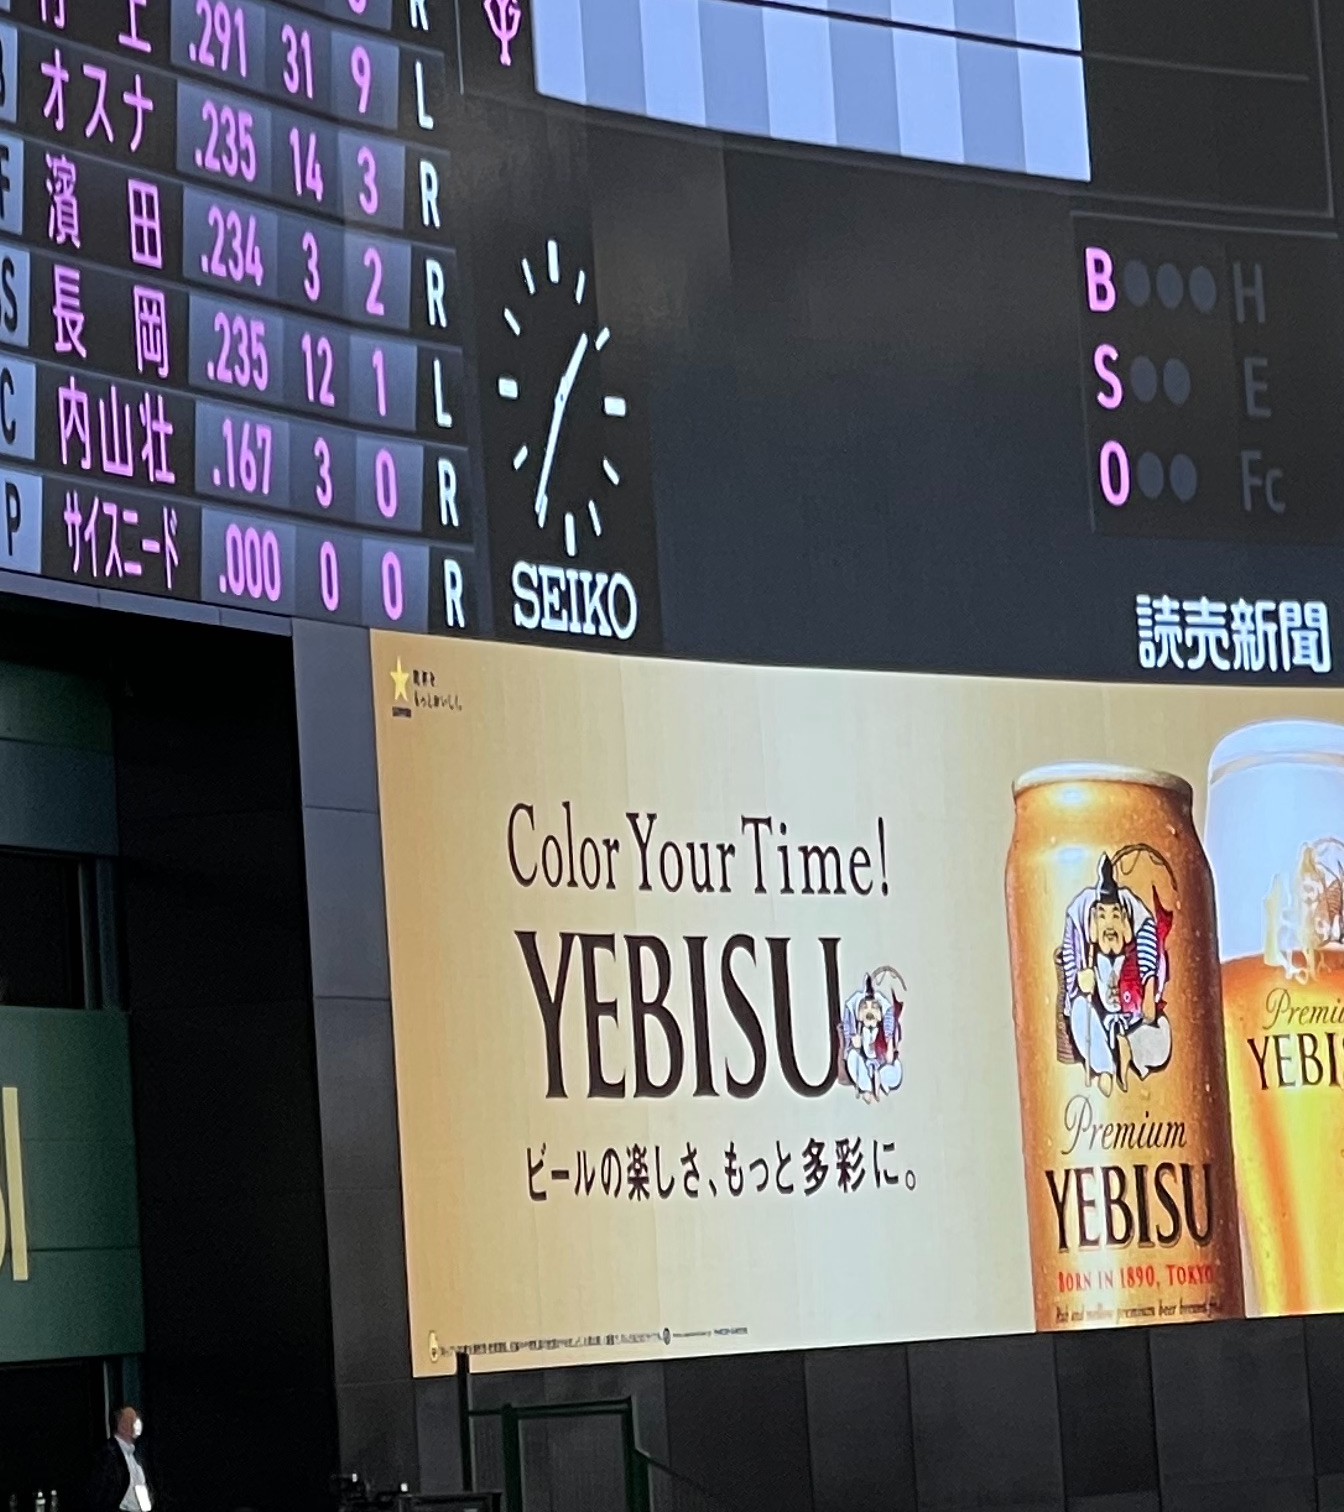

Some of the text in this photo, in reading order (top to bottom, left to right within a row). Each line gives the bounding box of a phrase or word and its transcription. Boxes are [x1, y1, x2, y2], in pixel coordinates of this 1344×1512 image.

[280, 23, 314, 99] 31
[40, 48, 154, 153] オスナ
[194, 99, 257, 183] .235
[289, 126, 324, 203] 14
[201, 205, 264, 286] .234
[1085, 246, 1266, 324] B H
[206, 312, 269, 392] .235
[300, 332, 336, 408] 12
[1093, 343, 1272, 418] S E
[57, 375, 176, 486] 内山壮
[212, 418, 274, 496] .167
[1099, 440, 1131, 507] O
[4, 480, 283, 603] P サイスニード .000
[511, 559, 639, 641] SEIKO
[1135, 594, 1333, 675] 読売新聞
[506, 800, 891, 898] Color Your Time!
[514, 929, 843, 1101] YEBISU
[1060, 1092, 1188, 1156] Premium
[525, 1137, 918, 1202] ビールの楽しさ、もっと多彩に。
[1044, 1160, 1214, 1255] YEBISU
[1057, 1271, 1092, 1294] BORN
[1097, 1269, 1114, 1290] IN
[1164, 1263, 1216, 1287] TOKYO
